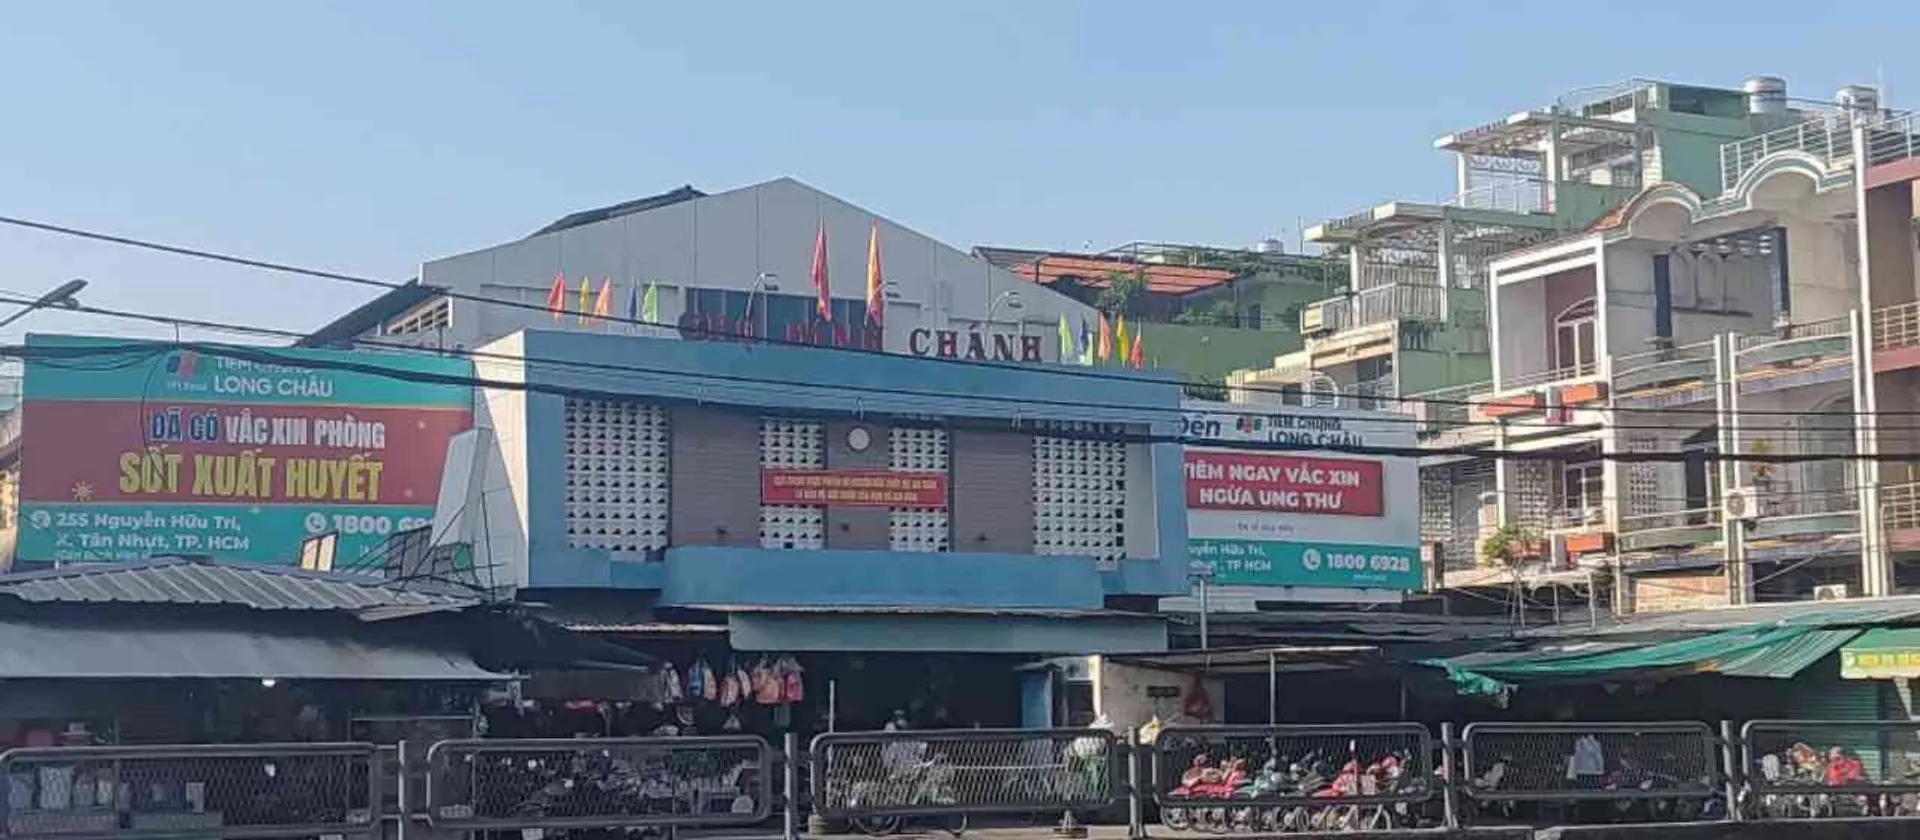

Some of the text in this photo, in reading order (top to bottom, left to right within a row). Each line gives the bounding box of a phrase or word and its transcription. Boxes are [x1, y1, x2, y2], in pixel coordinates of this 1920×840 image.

[910, 323, 1042, 363] CHÁNH
[214, 375, 272, 396] LONG
[277, 375, 334, 397] CHÂU
[151, 407, 183, 442] ĐÃ
[189, 408, 218, 442] CÓ
[271, 416, 308, 446] XIN
[314, 415, 386, 450] PHÒNG
[119, 443, 384, 501] SỐT XUẤT HUYẾT
[1183, 459, 1225, 480] TIÊM
[1229, 464, 1281, 483] NGAY
[1328, 470, 1360, 488] XIN
[1199, 484, 1344, 510] NGỪA UNG THƯ
[55, 512, 88, 528] 255
[94, 510, 166, 531] Nguyễn
[171, 513, 208, 530] Hữu
[331, 513, 392, 535] 1800
[80, 532, 113, 548] Tân
[175, 535, 203, 550] TP.
[207, 536, 250, 551] HCM
[1243, 560, 1272, 573] HCM
[1326, 553, 1411, 573] 1800 6928
